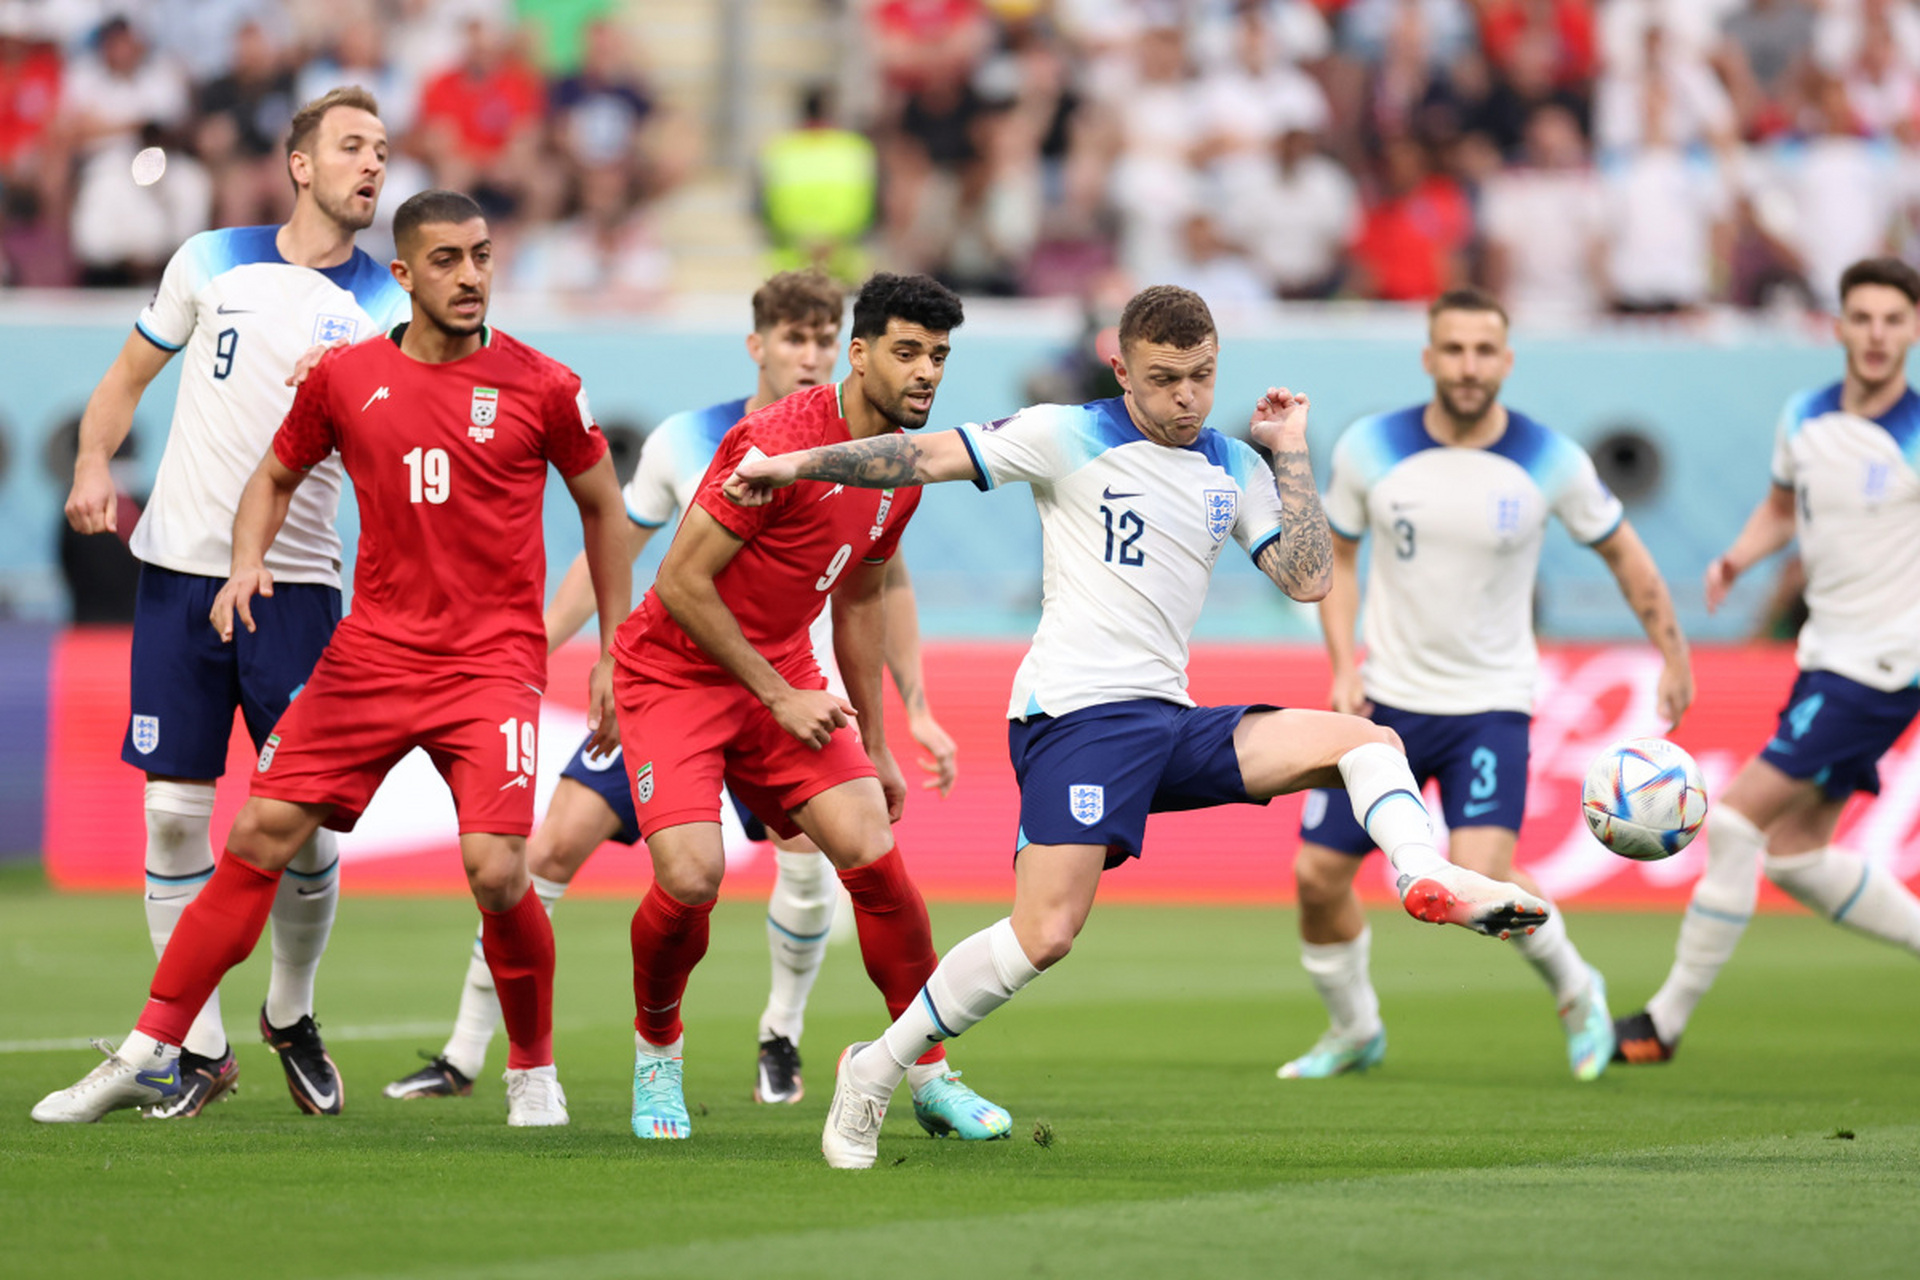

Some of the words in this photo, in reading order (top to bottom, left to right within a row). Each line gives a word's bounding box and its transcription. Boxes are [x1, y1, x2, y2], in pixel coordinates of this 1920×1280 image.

[213, 326, 239, 380] 9
[403, 447, 450, 505] 19
[1100, 505, 1145, 567] 12
[1394, 516, 1416, 561] 3
[815, 543, 853, 592] 9
[1788, 691, 1825, 741] 4
[499, 717, 535, 776] 19
[1469, 746, 1498, 800] 3
